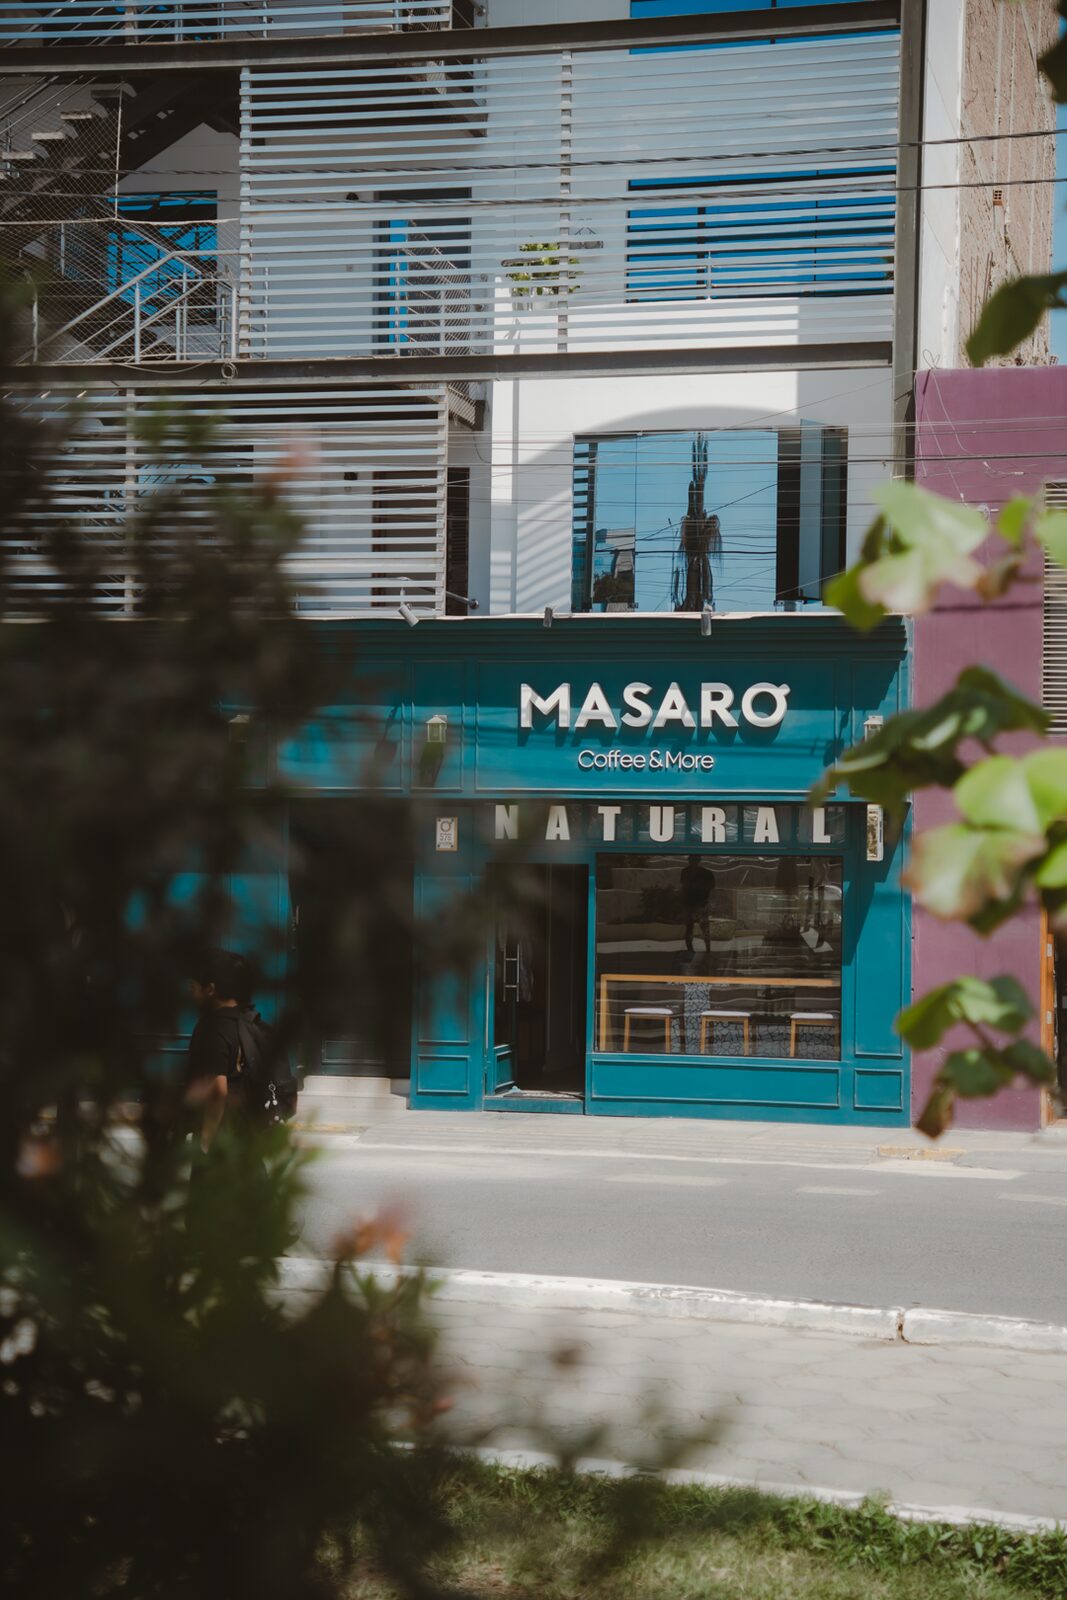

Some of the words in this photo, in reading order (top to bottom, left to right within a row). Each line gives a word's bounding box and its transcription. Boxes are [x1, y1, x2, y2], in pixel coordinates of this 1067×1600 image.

[520, 682, 792, 728] MASARO
[578, 749, 647, 770] Coffee
[665, 750, 715, 770] More
[494, 804, 831, 844] NATURAL
